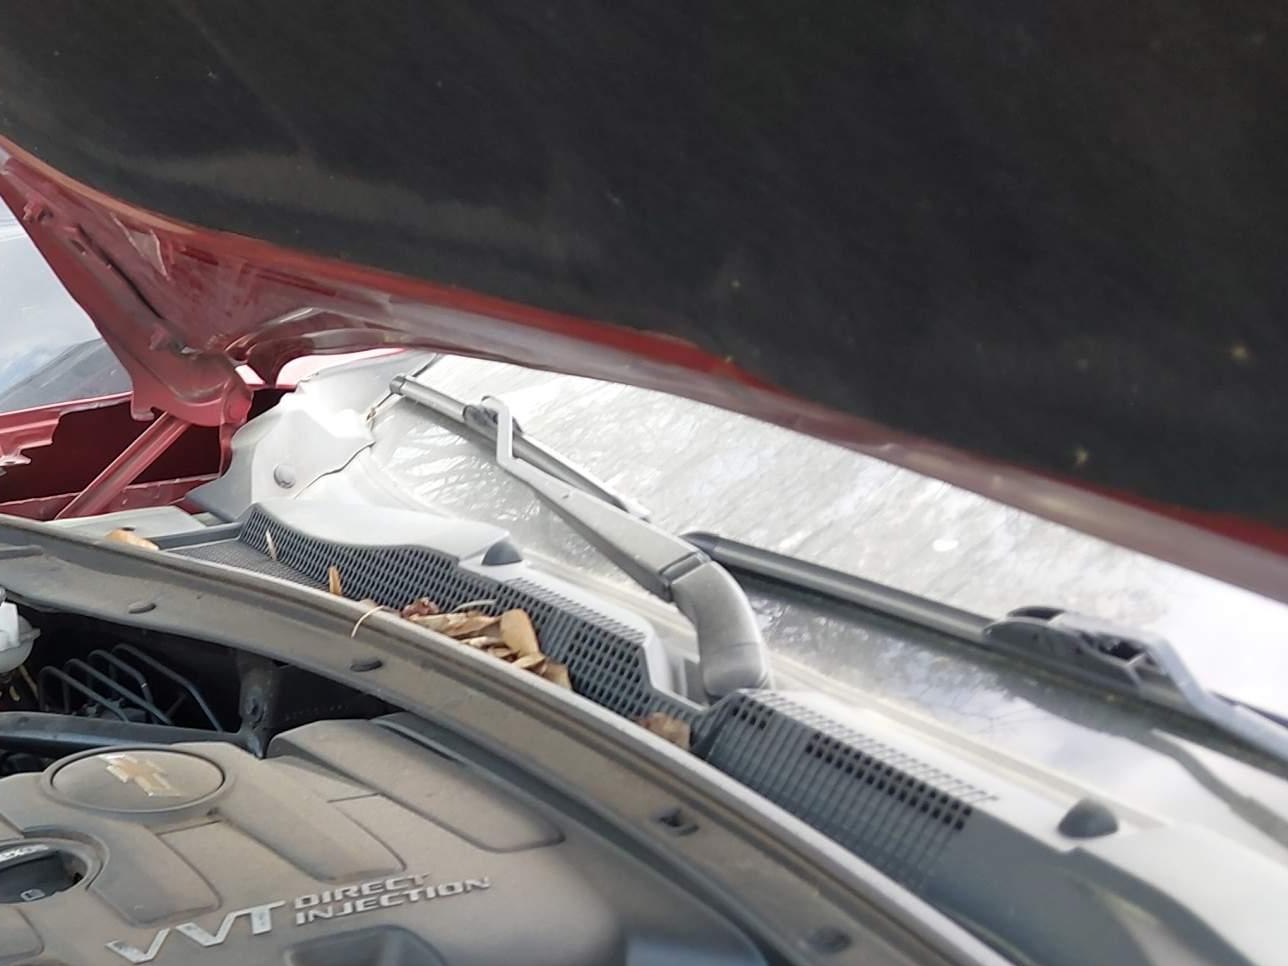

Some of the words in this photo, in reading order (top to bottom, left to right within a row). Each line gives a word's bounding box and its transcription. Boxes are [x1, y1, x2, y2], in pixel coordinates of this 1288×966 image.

[294, 872, 431, 911] DIRECT
[295, 876, 492, 927] INJECTION
[104, 900, 287, 965] VVT
